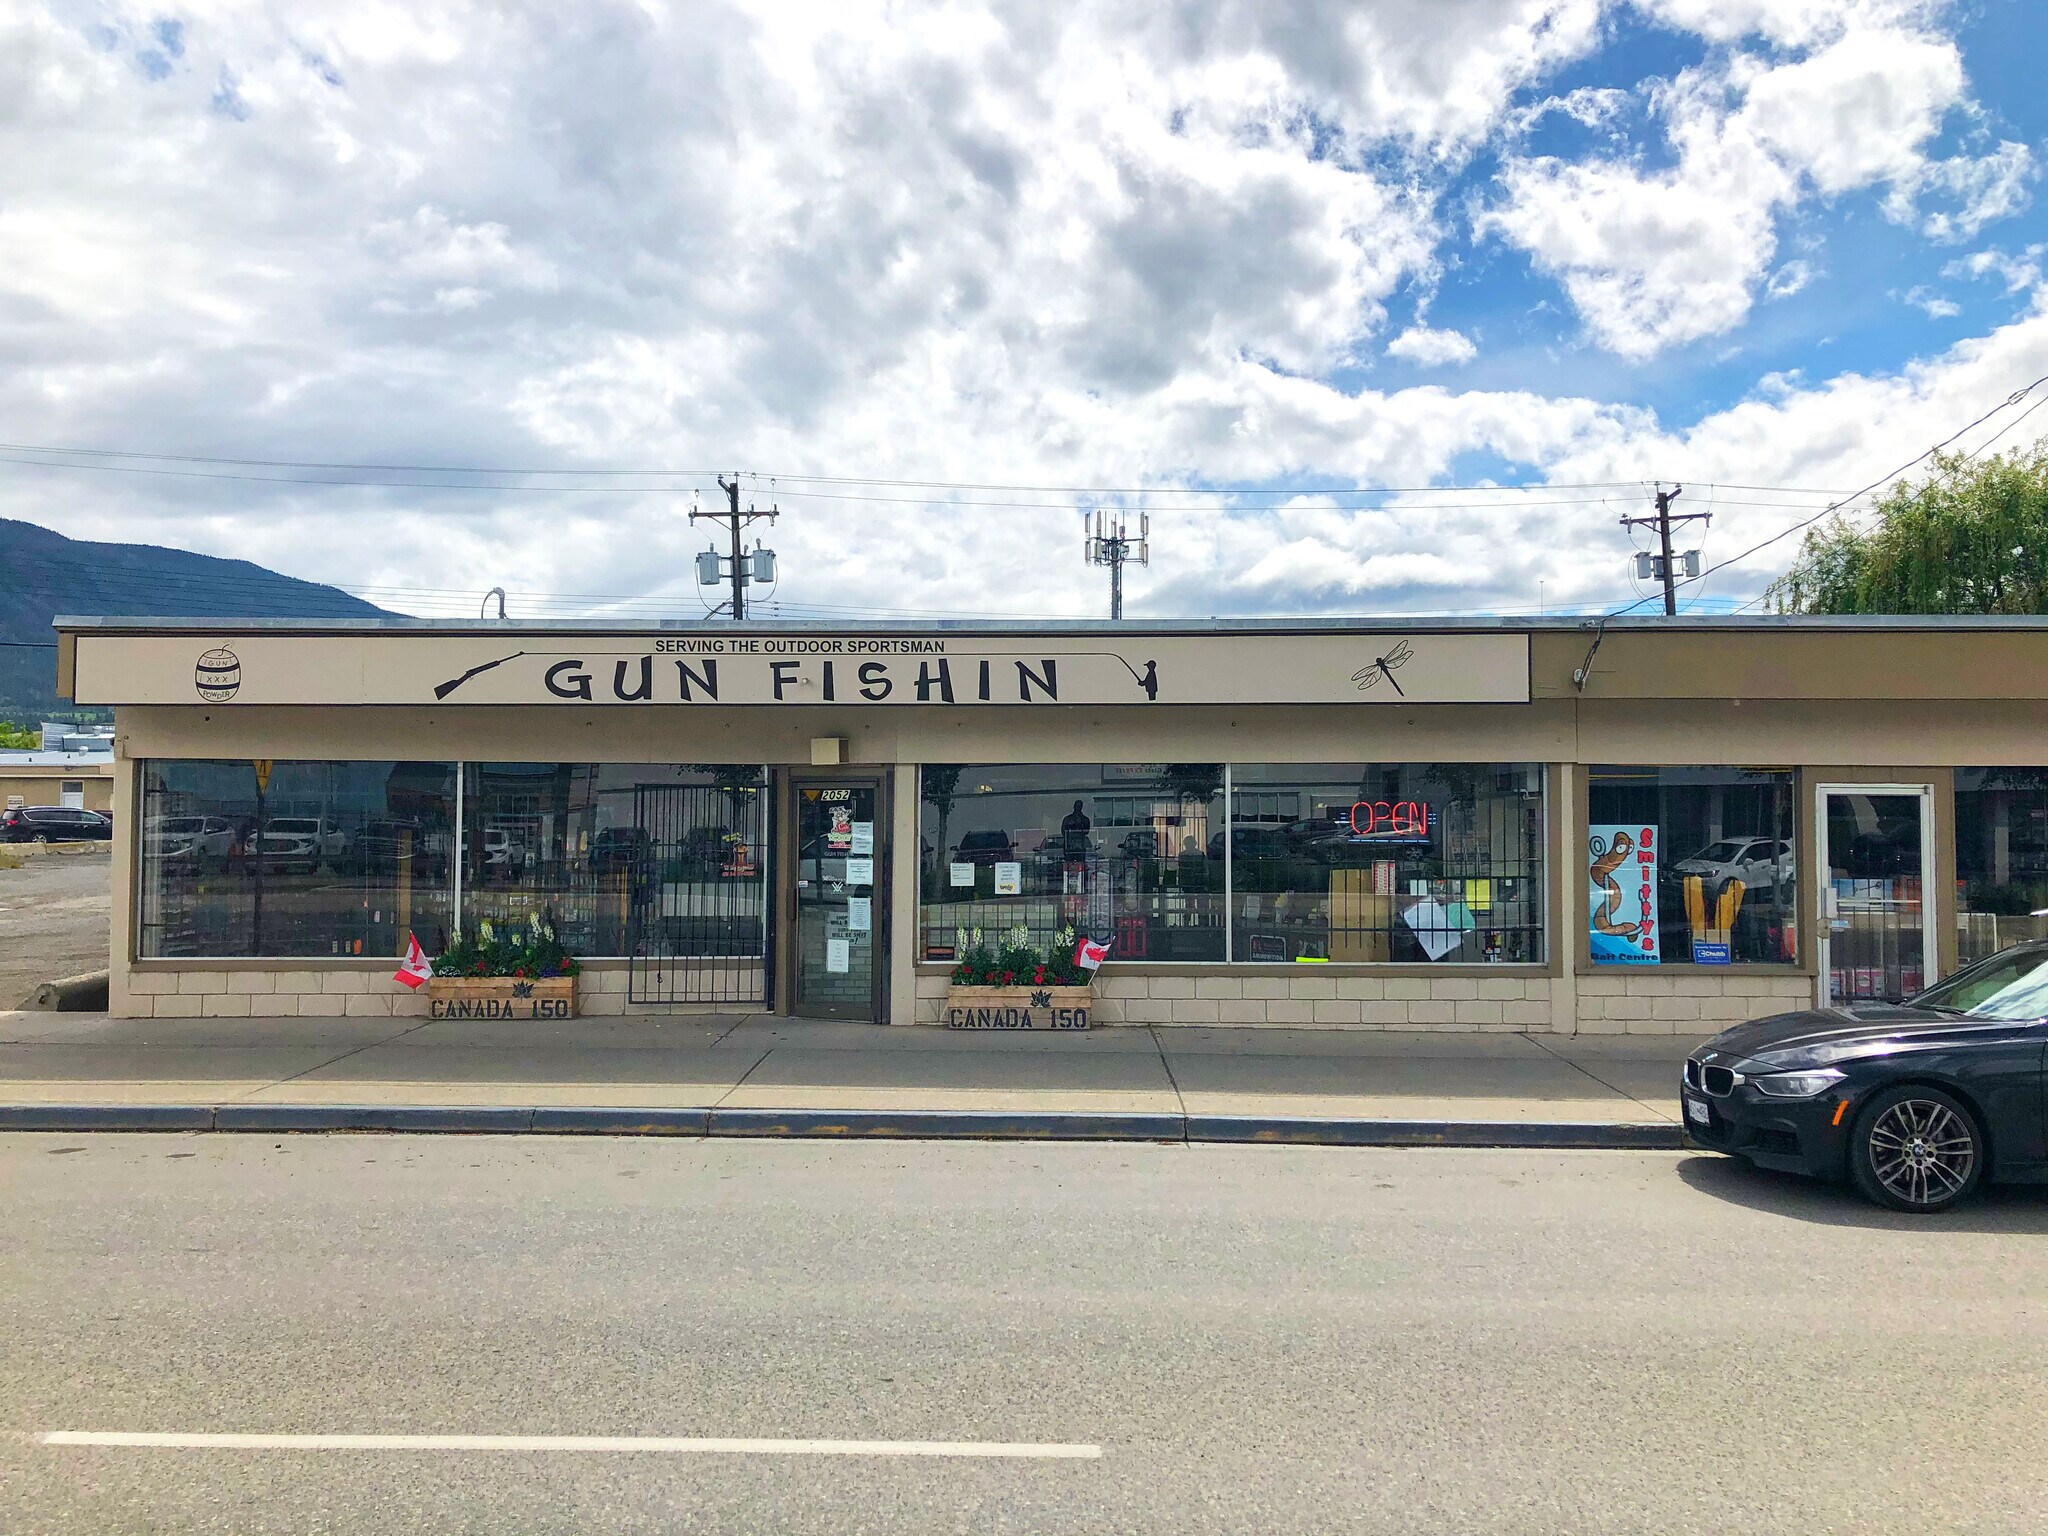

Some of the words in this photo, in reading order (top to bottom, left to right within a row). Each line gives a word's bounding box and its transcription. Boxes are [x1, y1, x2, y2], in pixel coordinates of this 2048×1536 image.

[655, 640, 724, 652] SERVING
[728, 640, 759, 652] THE
[764, 640, 843, 652] OUTDOOR
[847, 640, 945, 653] SPORTSMAN
[545, 655, 718, 702] GUN
[769, 658, 1058, 704] FISHIN
[202, 690, 231, 699] POWDER
[822, 790, 849, 800] 2052
[1351, 801, 1427, 835] OPEN
[1591, 953, 1616, 961] Bait
[1619, 953, 1659, 961] Centre
[431, 999, 514, 1019] CANADA
[531, 999, 569, 1019] 150
[950, 1008, 1033, 1029] CANADA
[1050, 1008, 1087, 1029] 150
